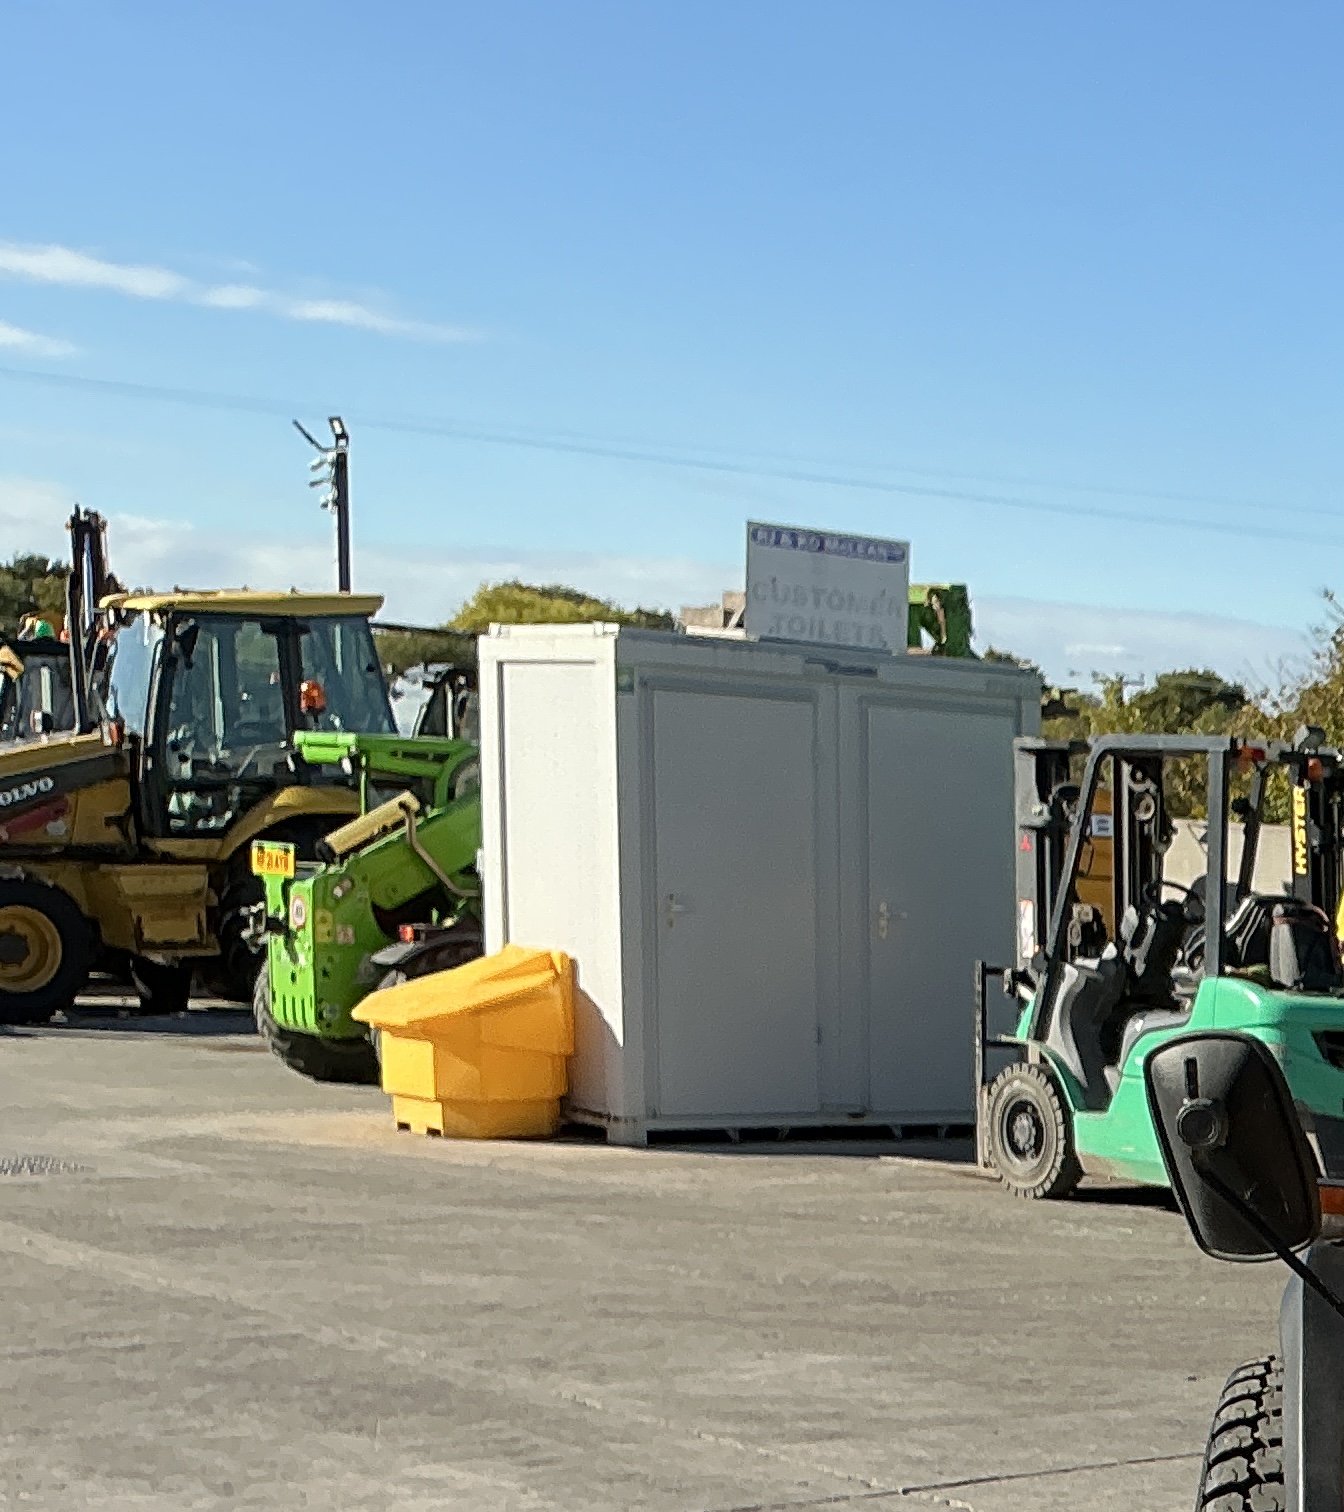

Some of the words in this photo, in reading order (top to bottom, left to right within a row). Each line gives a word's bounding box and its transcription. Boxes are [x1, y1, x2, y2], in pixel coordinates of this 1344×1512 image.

[752, 580, 903, 618] CUSTOMER
[770, 611, 884, 645] TOILETS
[1292, 784, 1307, 875] HYSTER
